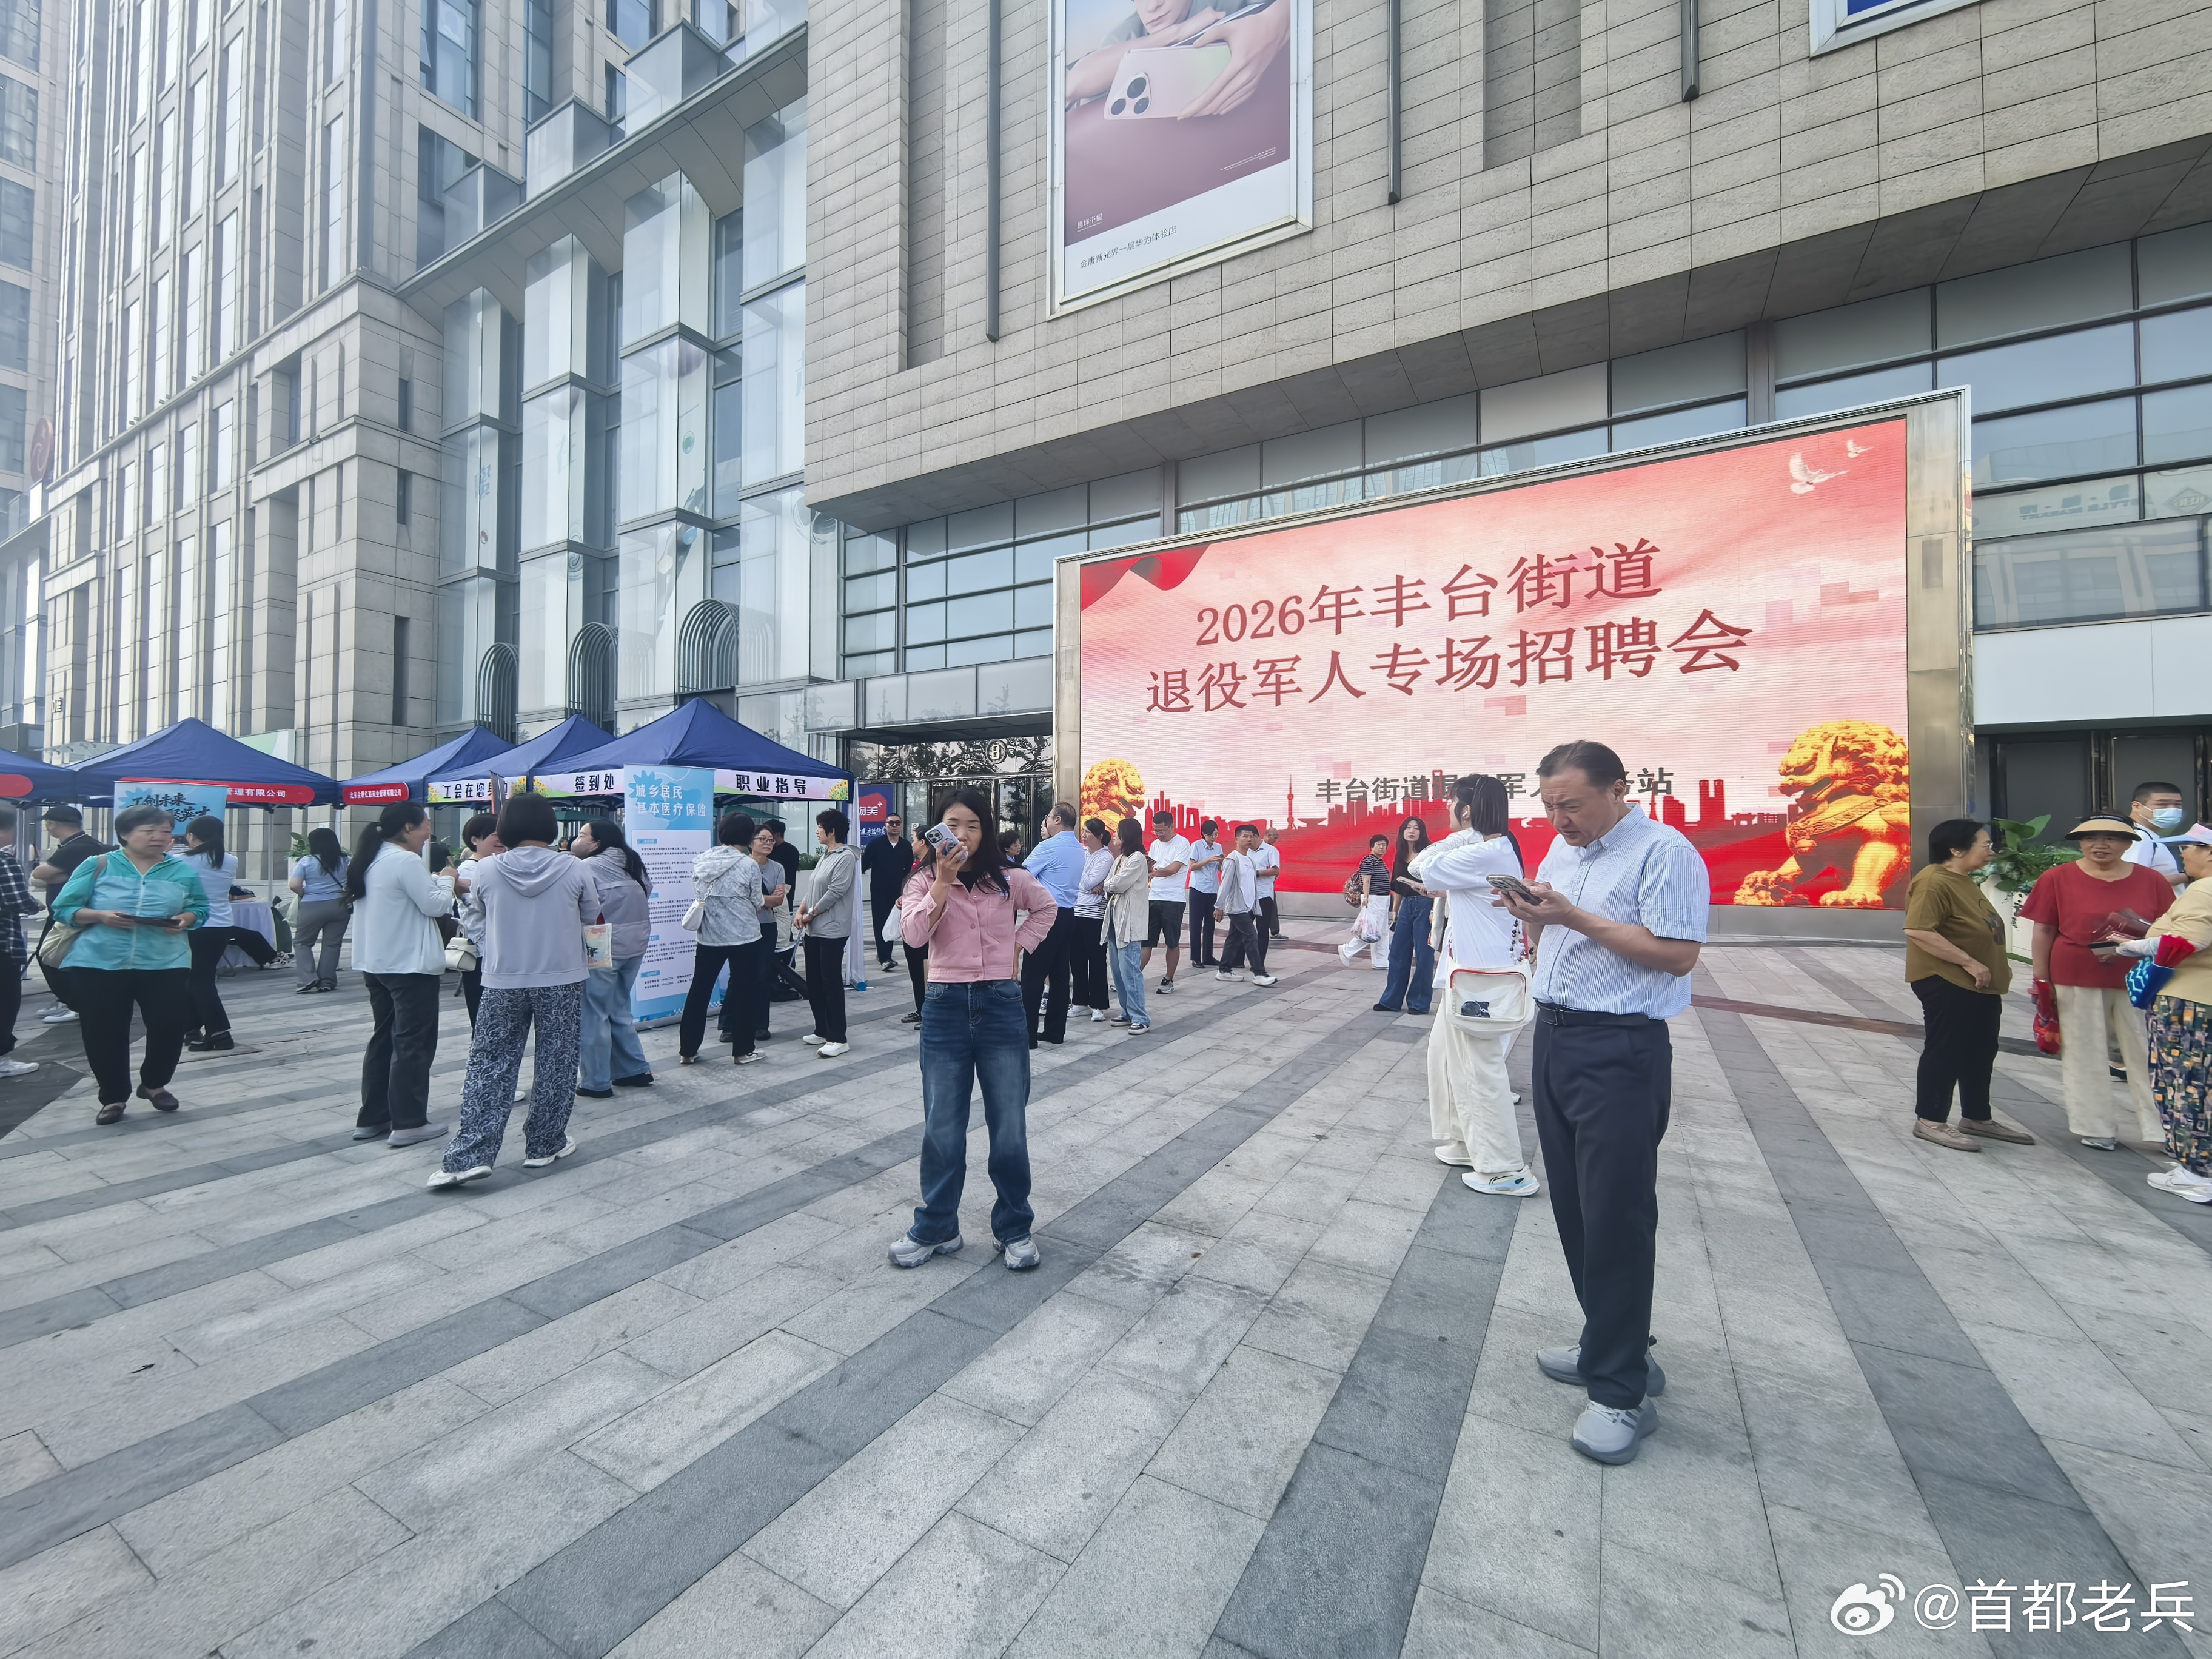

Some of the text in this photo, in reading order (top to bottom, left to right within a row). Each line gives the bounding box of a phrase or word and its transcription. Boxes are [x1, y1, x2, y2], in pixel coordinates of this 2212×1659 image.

[1196, 538, 1663, 645] 2026年丰台街道
[1146, 609, 1752, 712] 退役军人专场招聘会
[575, 773, 614, 792] 签到处
[635, 784, 682, 799] 城乡居民
[736, 774, 808, 795] 职业指导
[1316, 767, 1674, 803] 丰台街道退军站
[636, 802, 706, 816] 基本医疗保险
